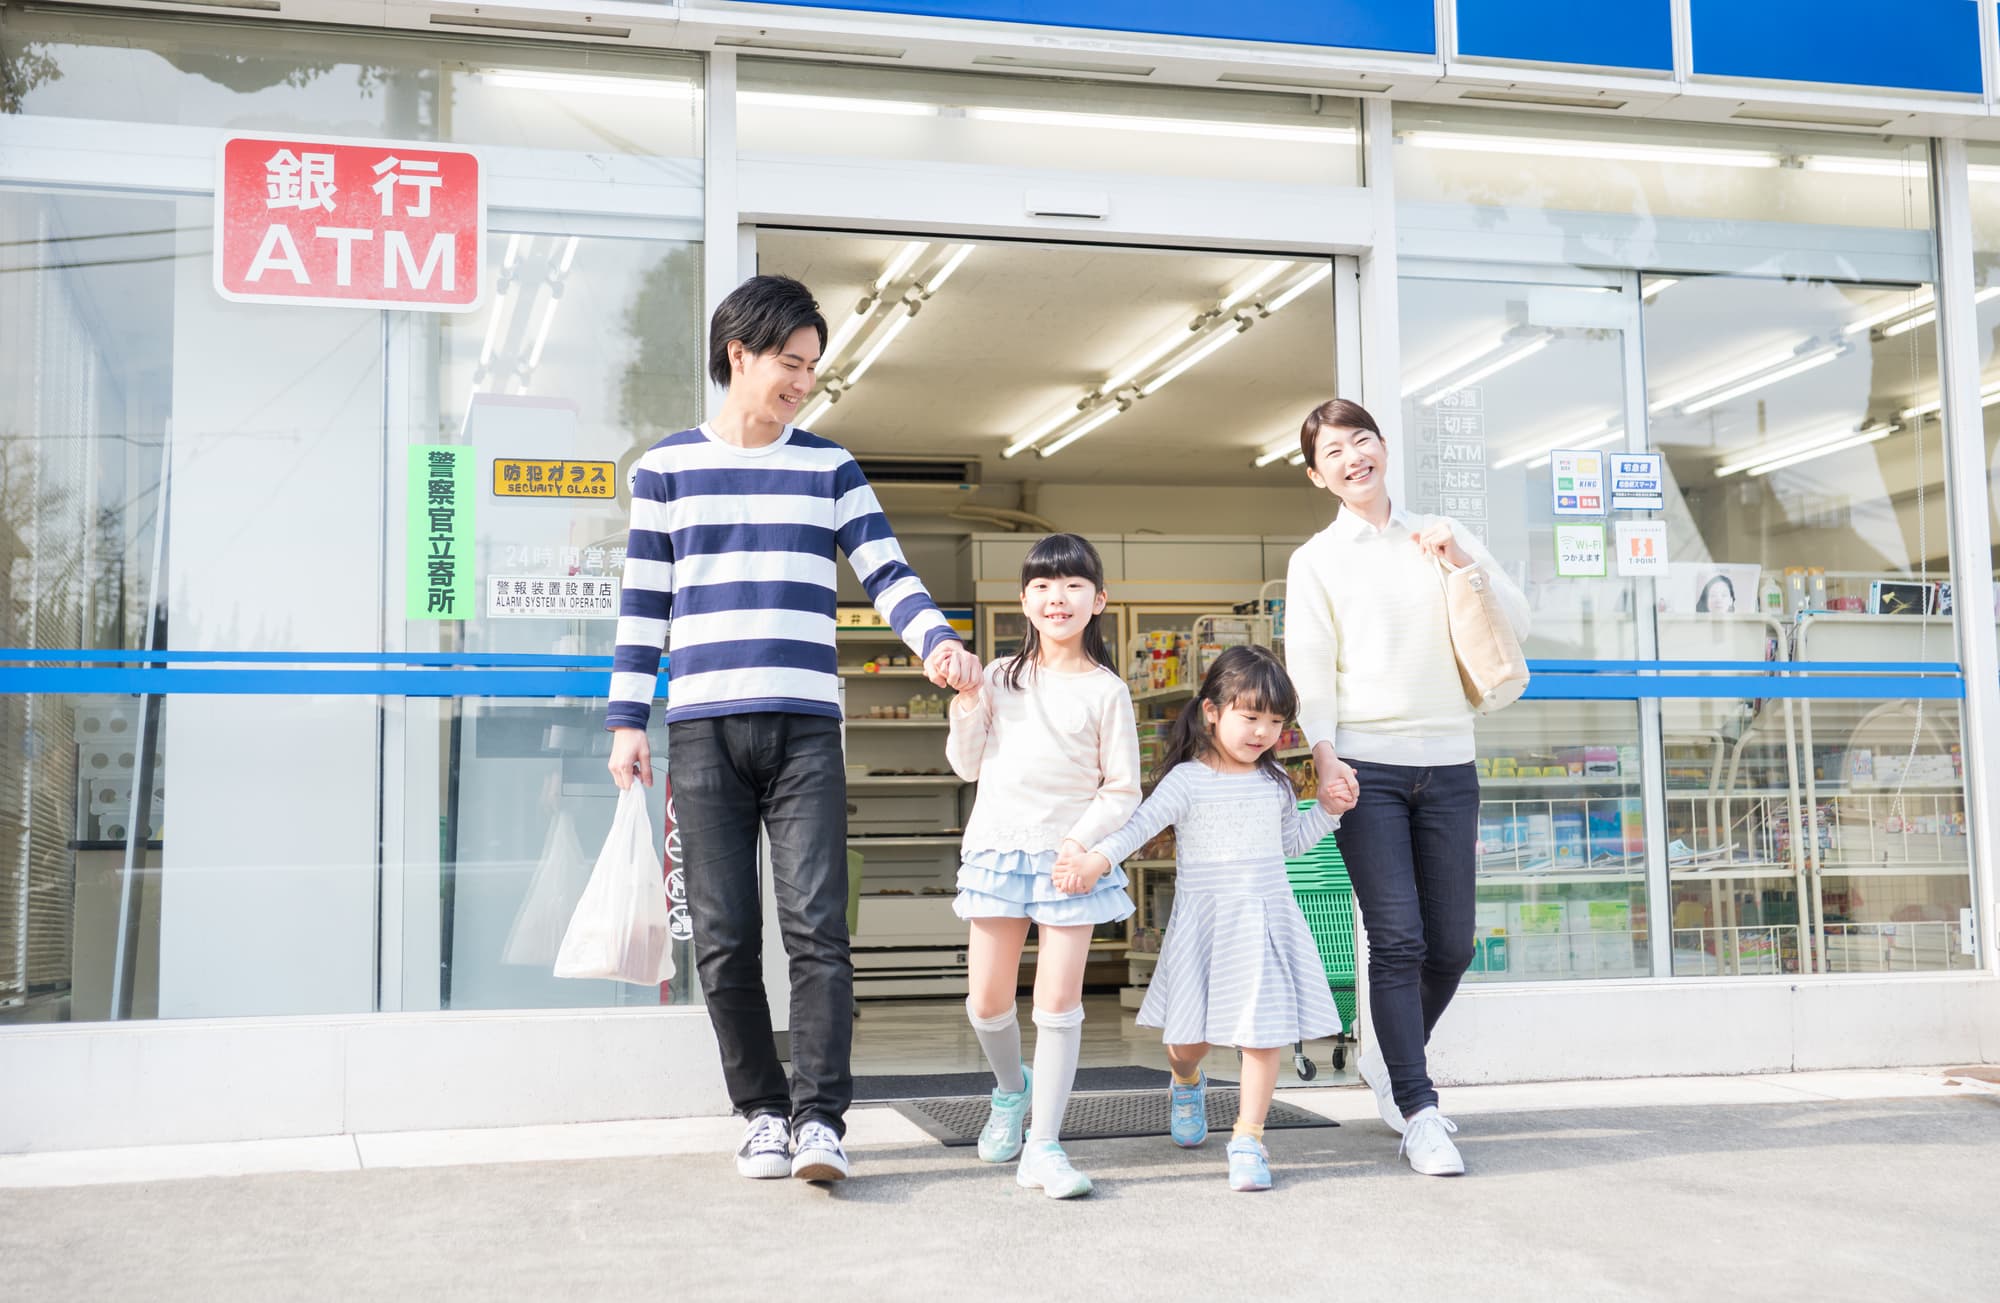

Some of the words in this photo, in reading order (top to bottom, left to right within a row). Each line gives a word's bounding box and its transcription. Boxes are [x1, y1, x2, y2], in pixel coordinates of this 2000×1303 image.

[264, 149, 443, 217] 銀行
[244, 223, 456, 291] ATM
[1444, 416, 1477, 434] 切手
[1443, 445, 1482, 461] ATM
[503, 464, 607, 483] 防犯ガラス
[1444, 471, 1481, 488] たばこ
[507, 483, 562, 495] SECURITY
[566, 485, 606, 495] GLASS
[427, 451, 456, 614] 警察官立寄所
[1562, 553, 1600, 562] つかえます
[497, 581, 612, 596] 警報装置設置店
[496, 596, 522, 607] ALARM
[525, 597, 556, 608] SYSTEM
[559, 598, 566, 607] IN
[570, 598, 612, 608] OPERATION
